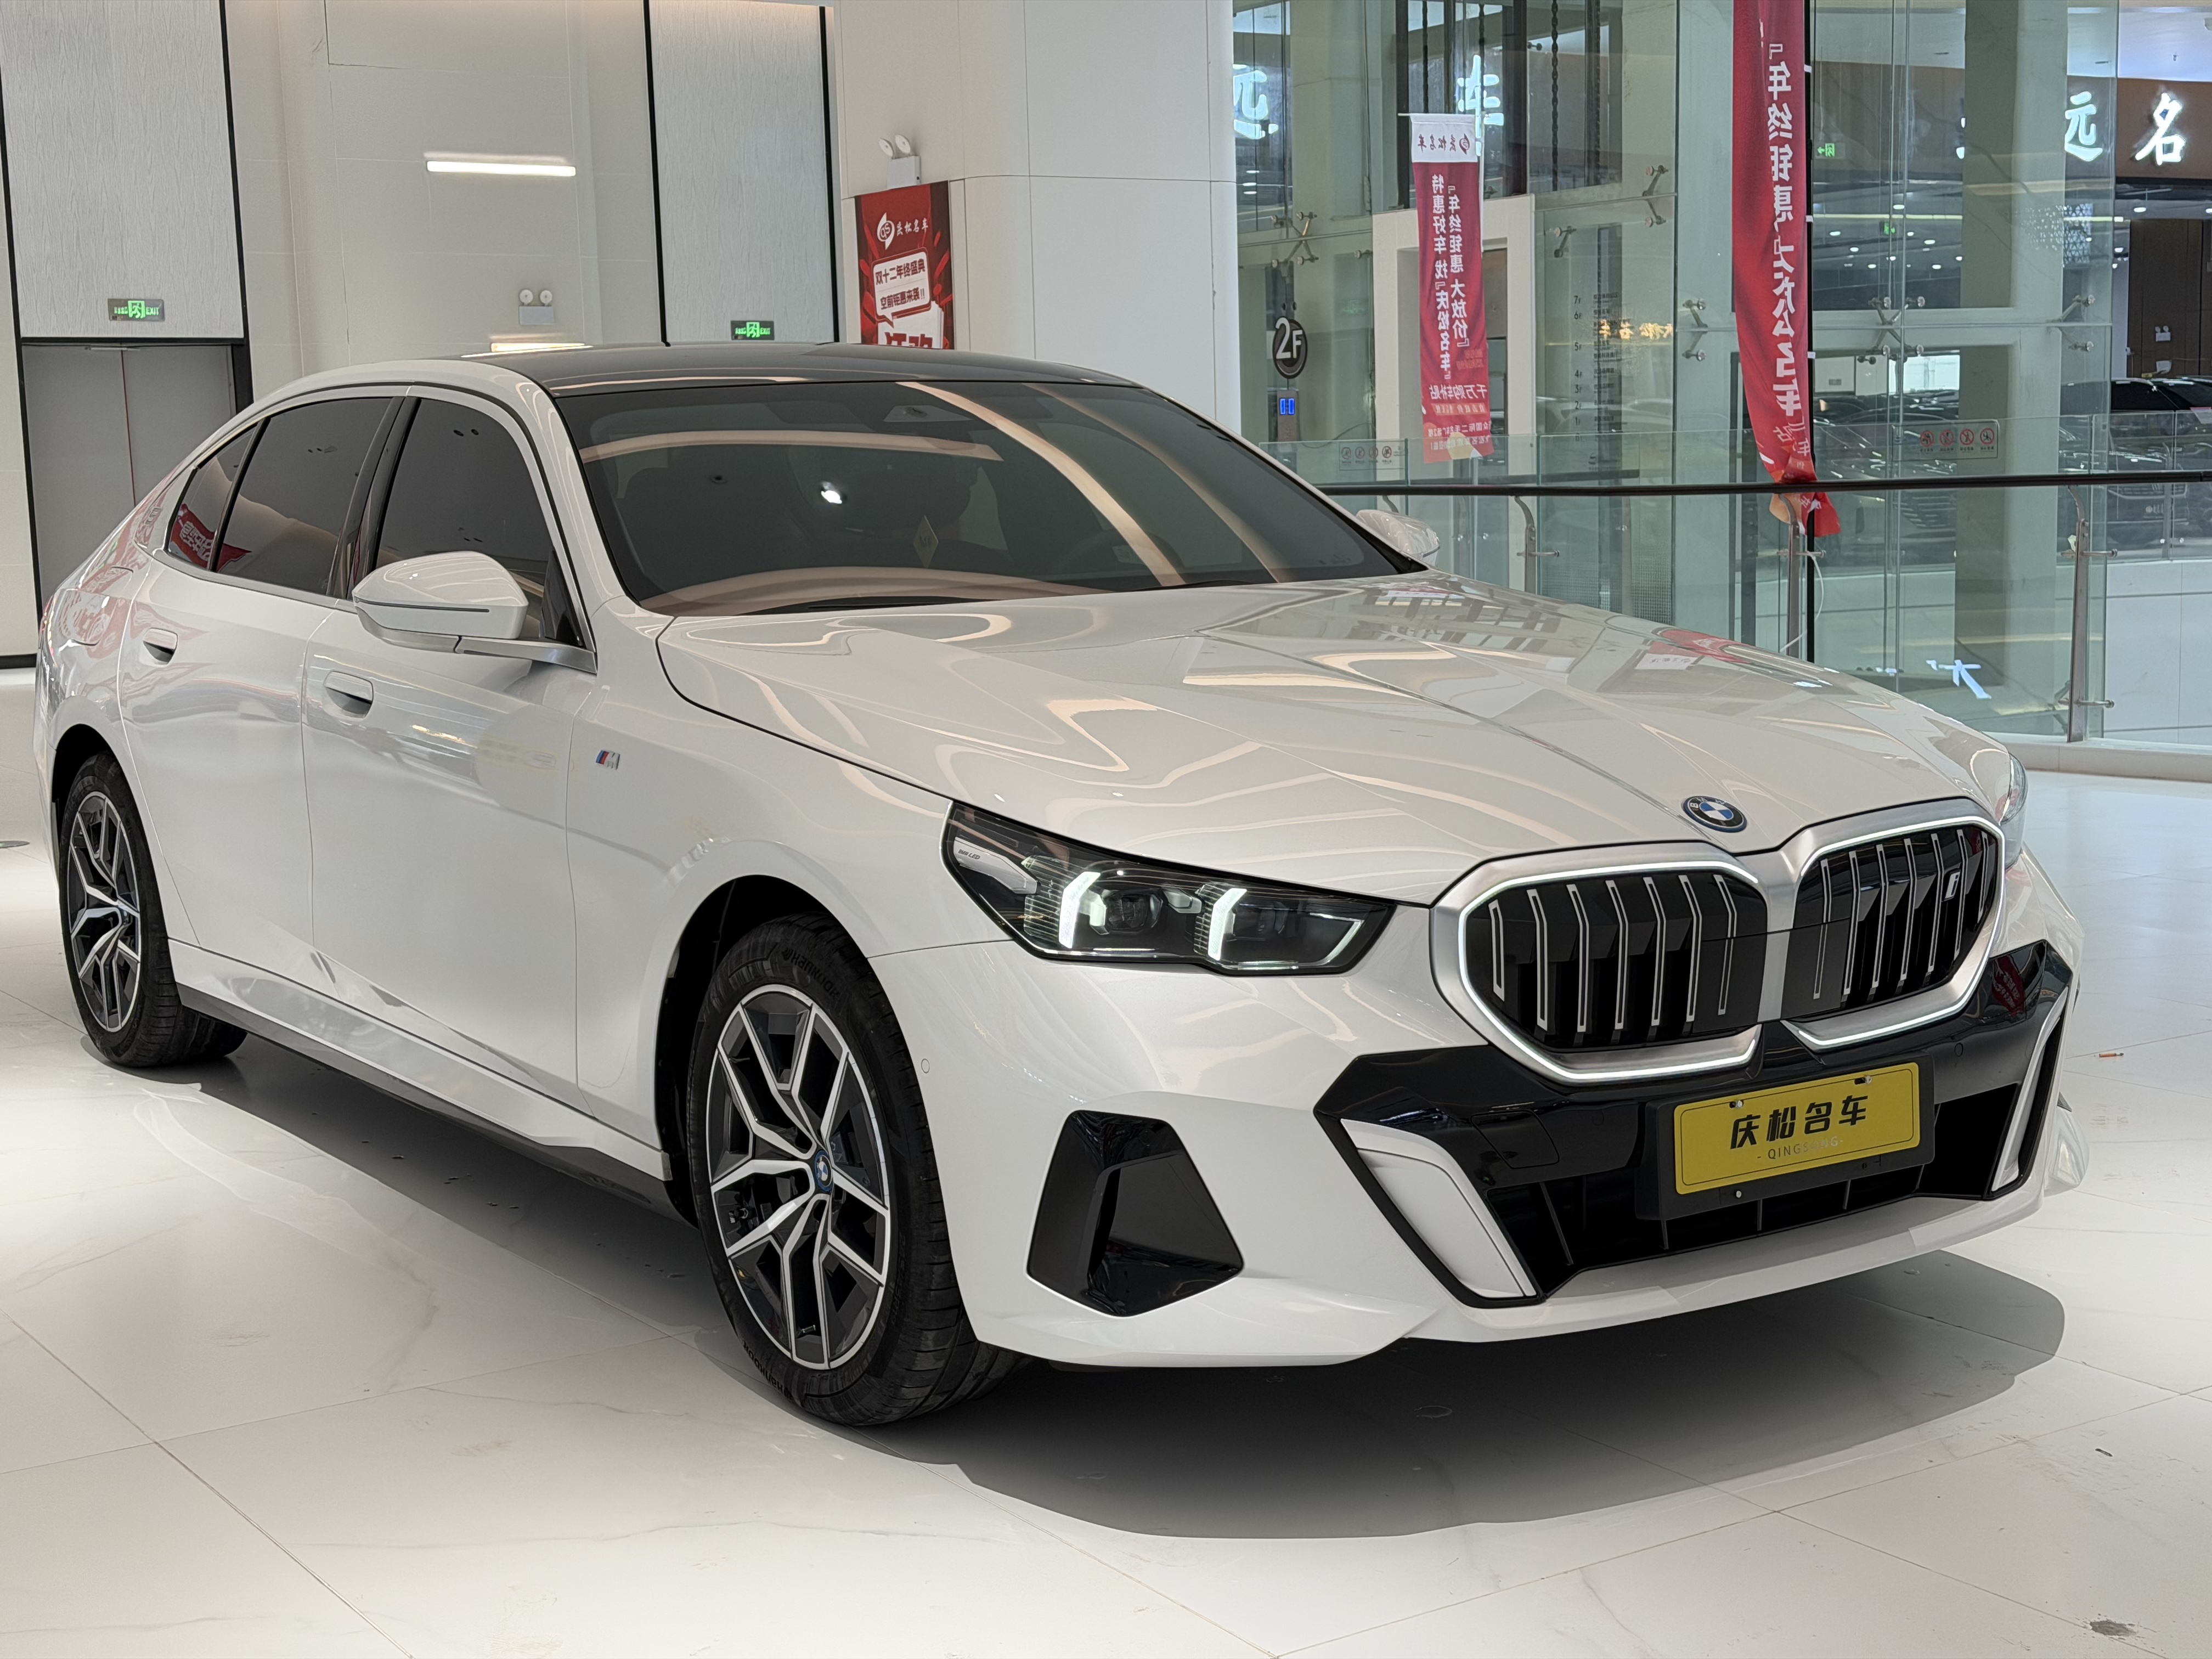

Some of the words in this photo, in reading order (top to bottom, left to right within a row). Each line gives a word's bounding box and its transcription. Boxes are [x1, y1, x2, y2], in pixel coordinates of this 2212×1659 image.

[875, 258, 926, 285] 双十二年终盛典
[145, 307, 160, 315] EXIT
[1275, 317, 1303, 360] 2F
[1730, 1095, 1869, 1150] 庆松名车
